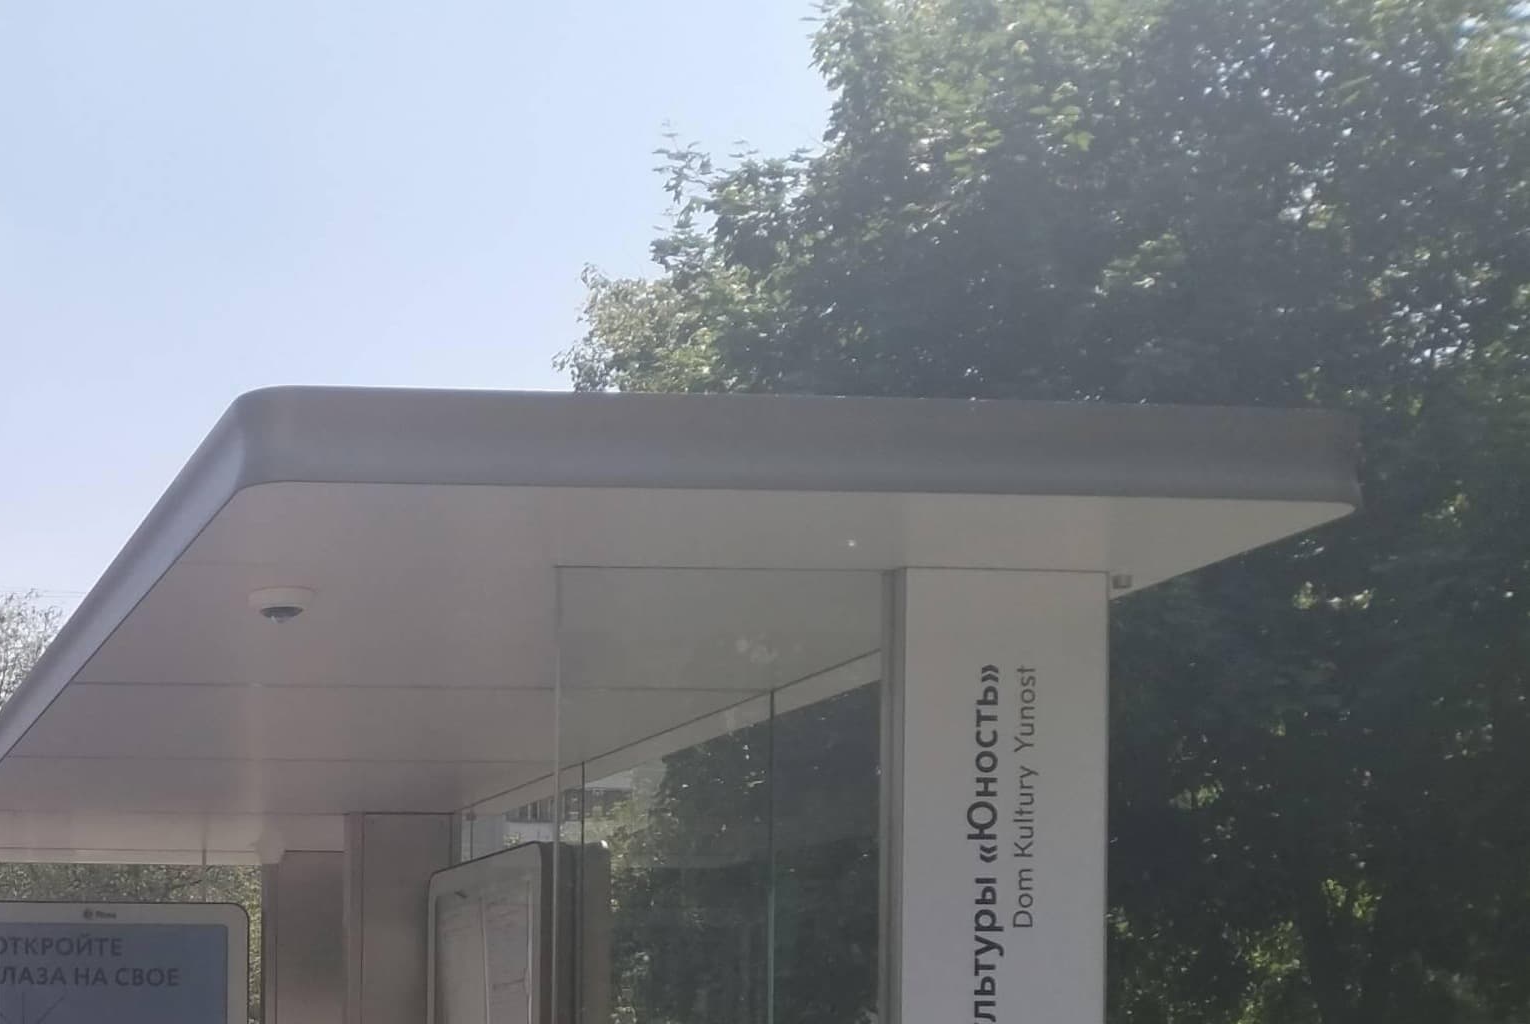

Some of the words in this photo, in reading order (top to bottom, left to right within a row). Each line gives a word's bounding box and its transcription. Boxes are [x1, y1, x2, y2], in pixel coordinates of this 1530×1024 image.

[1013, 665, 1037, 753] Yunost
[966, 664, 1001, 864] «Юность»
[1012, 764, 1040, 859] Kultury
[1011, 867, 1034, 929] Dom
[74, 967, 109, 987] НА
[114, 967, 180, 987] СВОЕ
